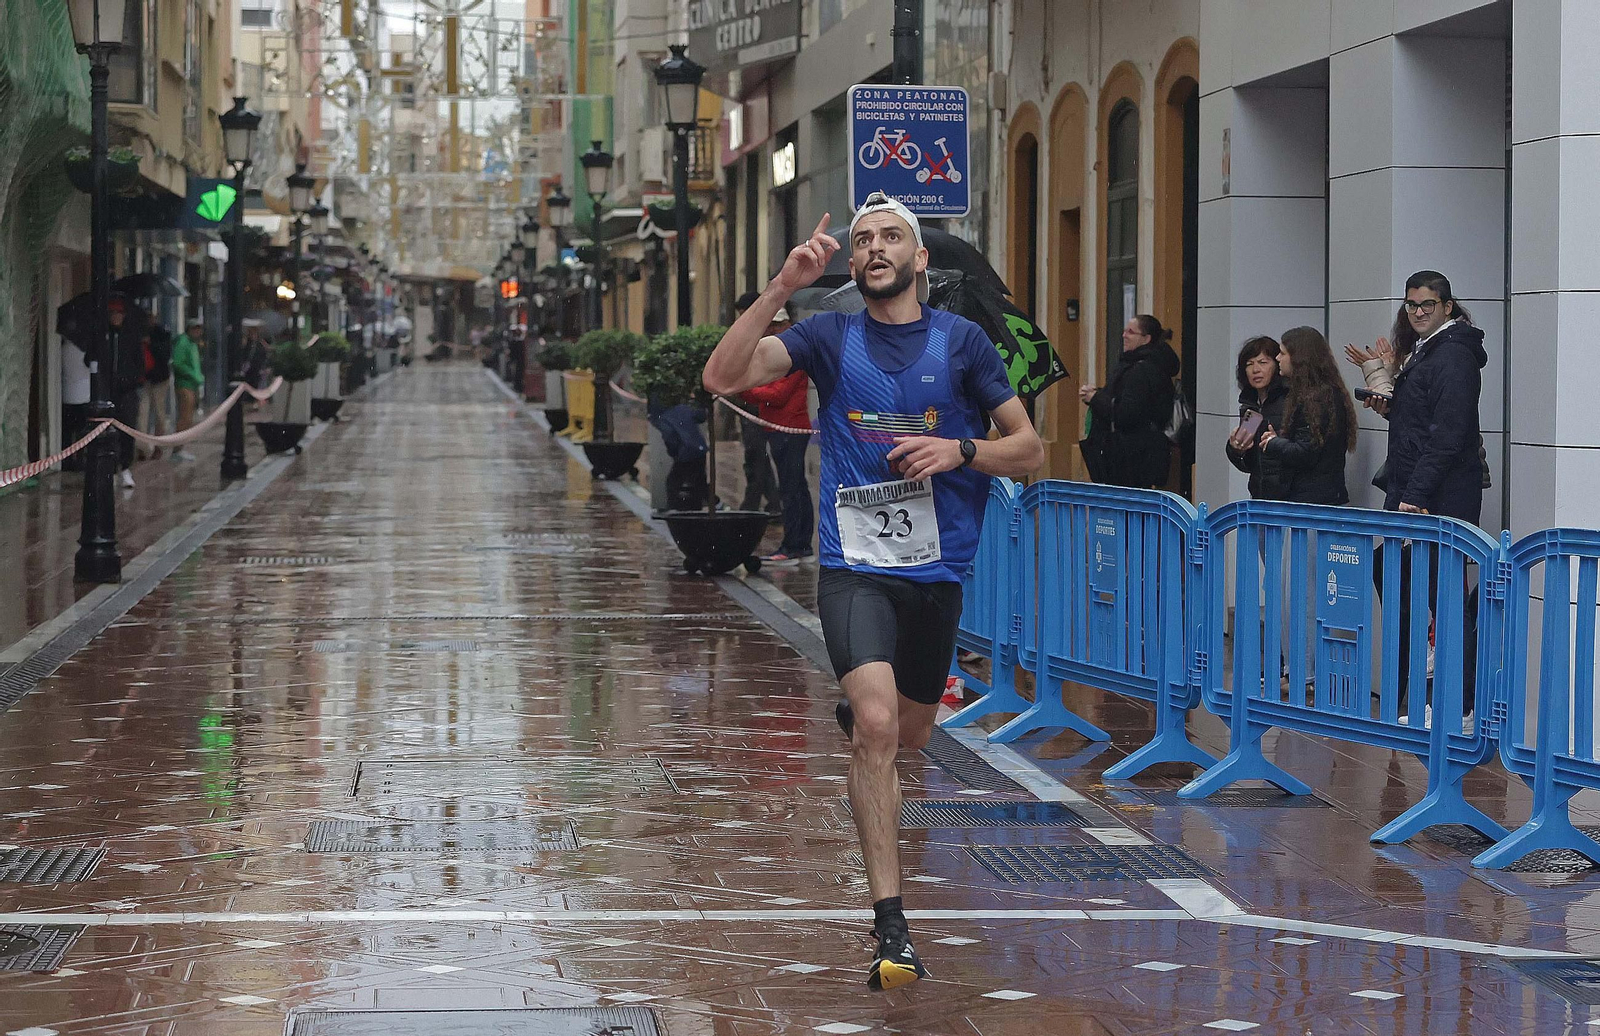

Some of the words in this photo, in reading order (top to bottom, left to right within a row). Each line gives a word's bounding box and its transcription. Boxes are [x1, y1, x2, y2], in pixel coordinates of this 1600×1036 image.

[855, 90, 890, 99] ZONA
[897, 91, 964, 101] PEATONAL
[856, 101, 902, 110] PROHIBIDO
[903, 102, 944, 111] CIRCULAR
[945, 103, 964, 111] CON
[856, 112, 905, 121] BICICLETAS
[909, 113, 915, 121] Y
[920, 113, 964, 122] PATINETES
[921, 195, 936, 204] 200
[938, 195, 944, 204] €
[874, 508, 913, 538] 23
[1327, 551, 1360, 565] DEPORTES
